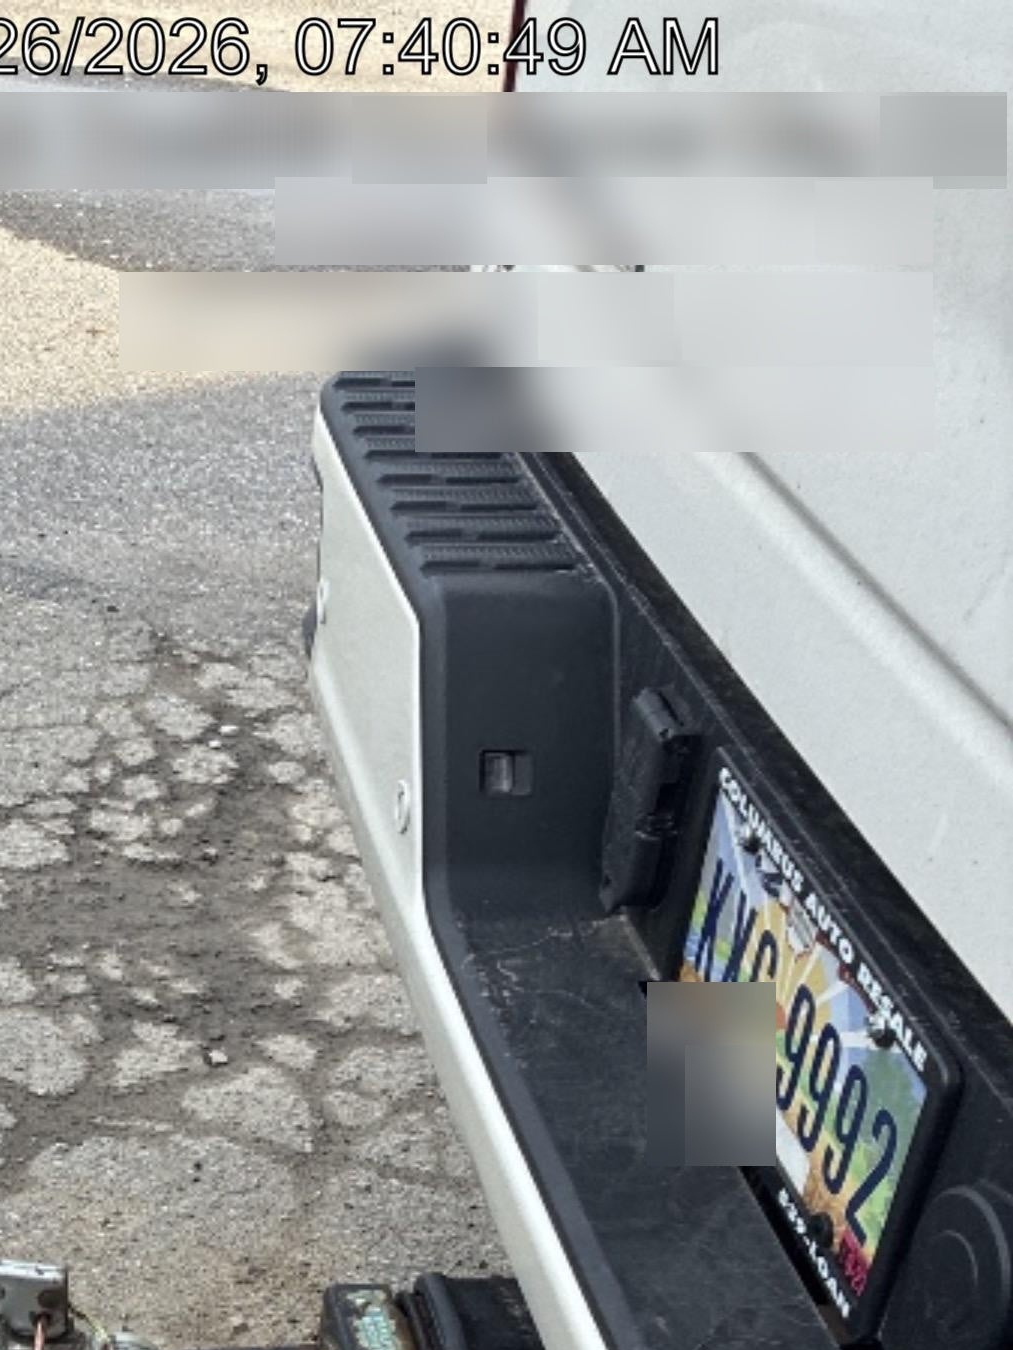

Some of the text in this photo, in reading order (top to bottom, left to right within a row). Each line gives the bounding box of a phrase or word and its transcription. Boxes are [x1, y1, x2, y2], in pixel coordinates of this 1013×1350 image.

[719, 766, 928, 1073] COLUMBUS AUTO RESALE
